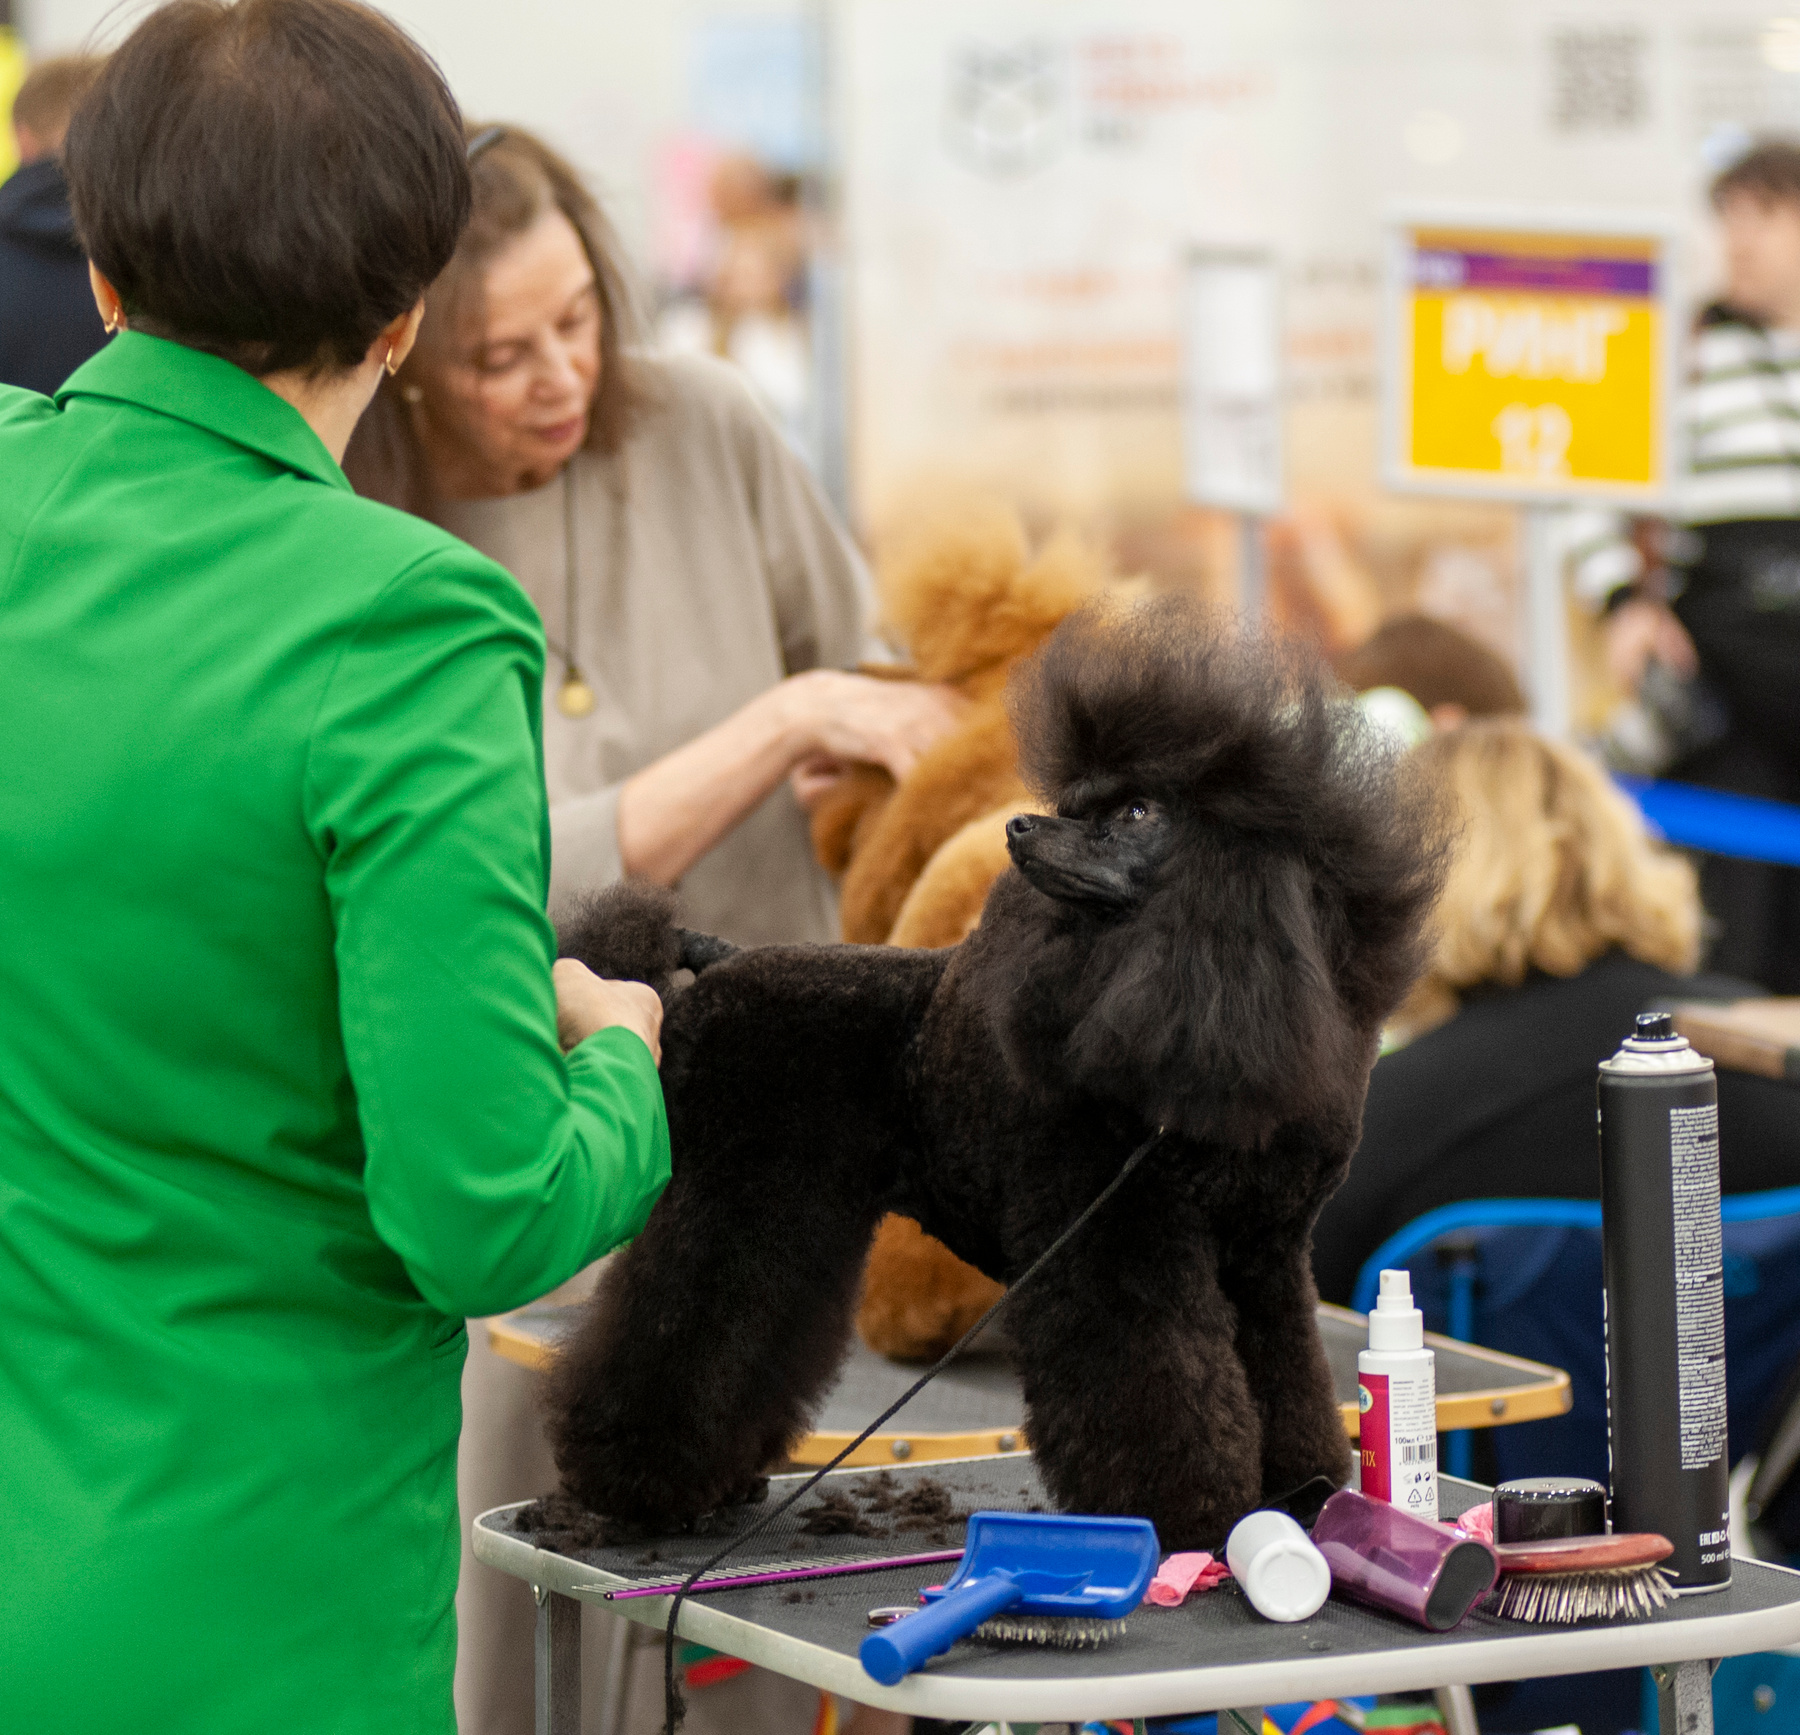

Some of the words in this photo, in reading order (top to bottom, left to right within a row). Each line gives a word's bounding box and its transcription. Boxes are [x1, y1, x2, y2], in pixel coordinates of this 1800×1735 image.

[1444, 300, 1628, 382] РИНГ
[1362, 1449, 1376, 1468] FIX
[1701, 1553, 1716, 1564] 500
